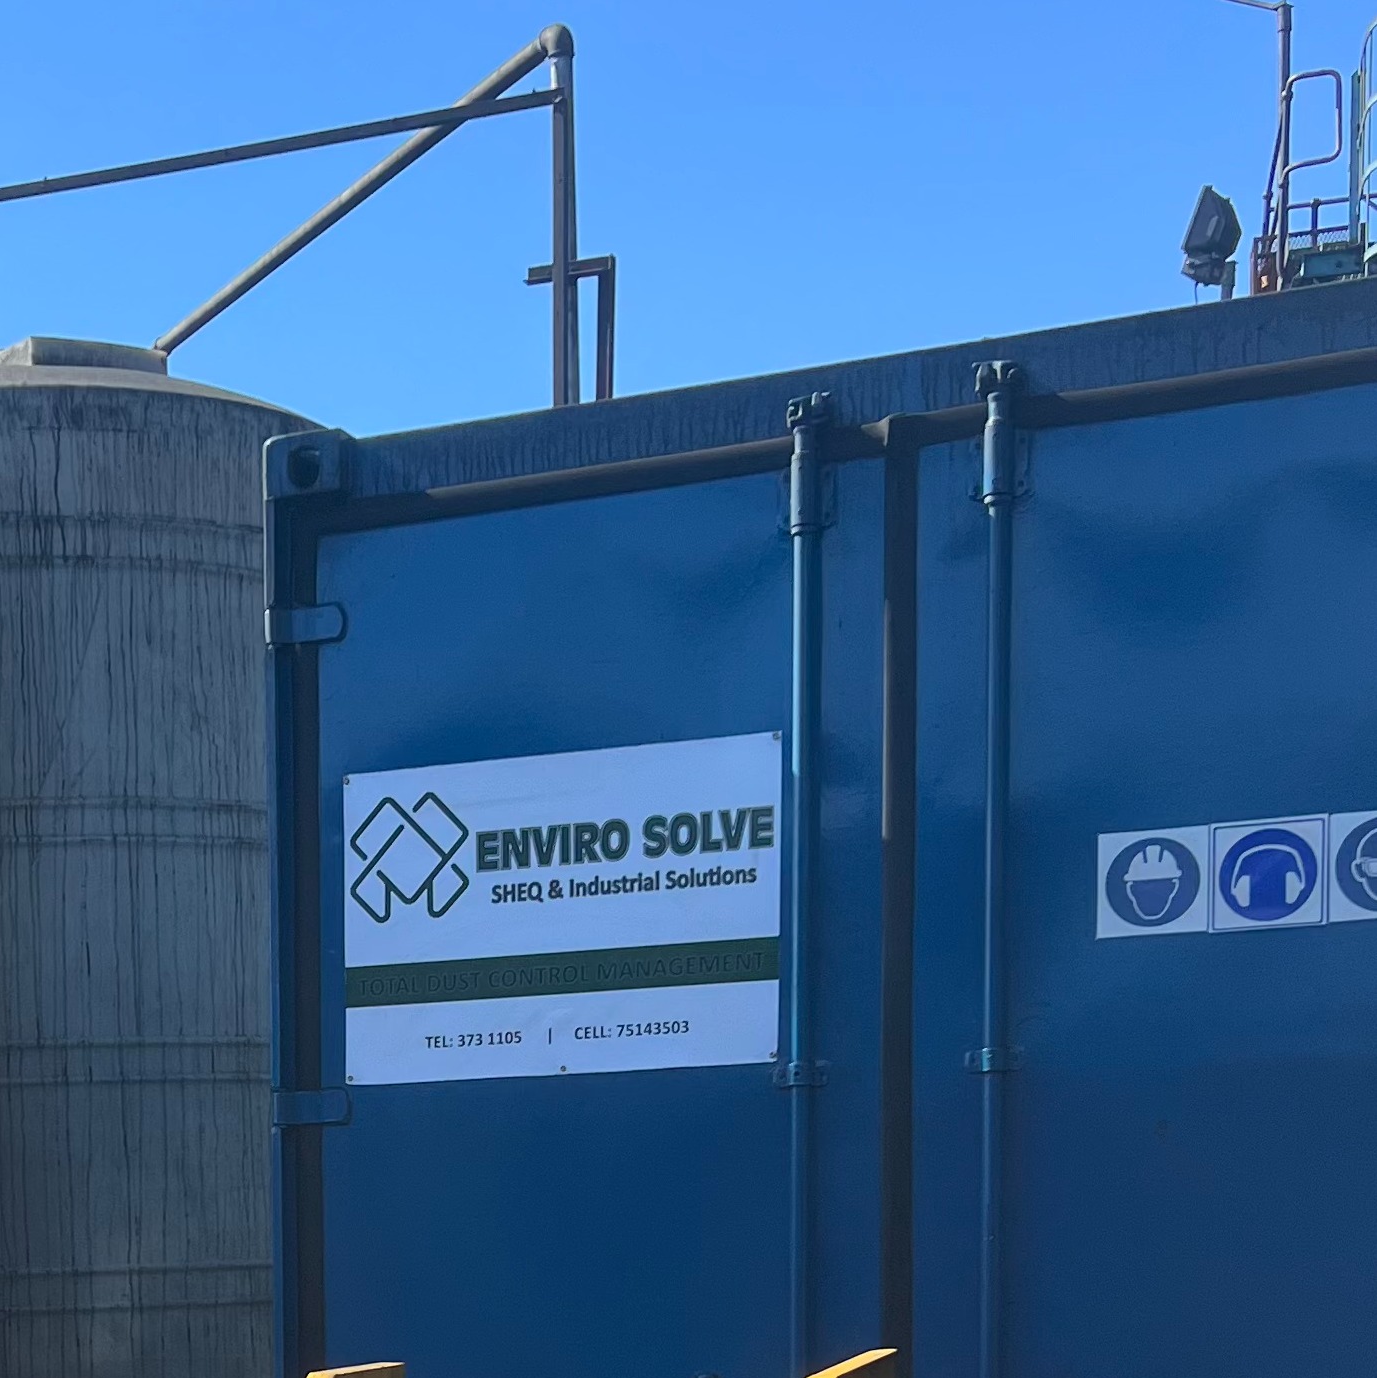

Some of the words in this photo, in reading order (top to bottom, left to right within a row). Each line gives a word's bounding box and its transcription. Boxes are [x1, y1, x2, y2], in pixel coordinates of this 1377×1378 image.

[475, 820, 630, 873] ENVIRO
[642, 806, 775, 859] SOLVE
[491, 883, 543, 904] SHEQ
[549, 880, 563, 899] &
[569, 871, 660, 898] Industrial
[665, 865, 757, 890] Solutions
[359, 974, 419, 996] TOTAL
[427, 971, 480, 993] DUST
[489, 965, 589, 988] CONTROL
[597, 951, 765, 981] MANAGEMENT
[425, 1035, 453, 1050] TEL:
[458, 1033, 483, 1048] 373
[487, 1030, 522, 1045] 1105
[574, 1025, 612, 1041] CELL:
[616, 1020, 690, 1038] 75143503
